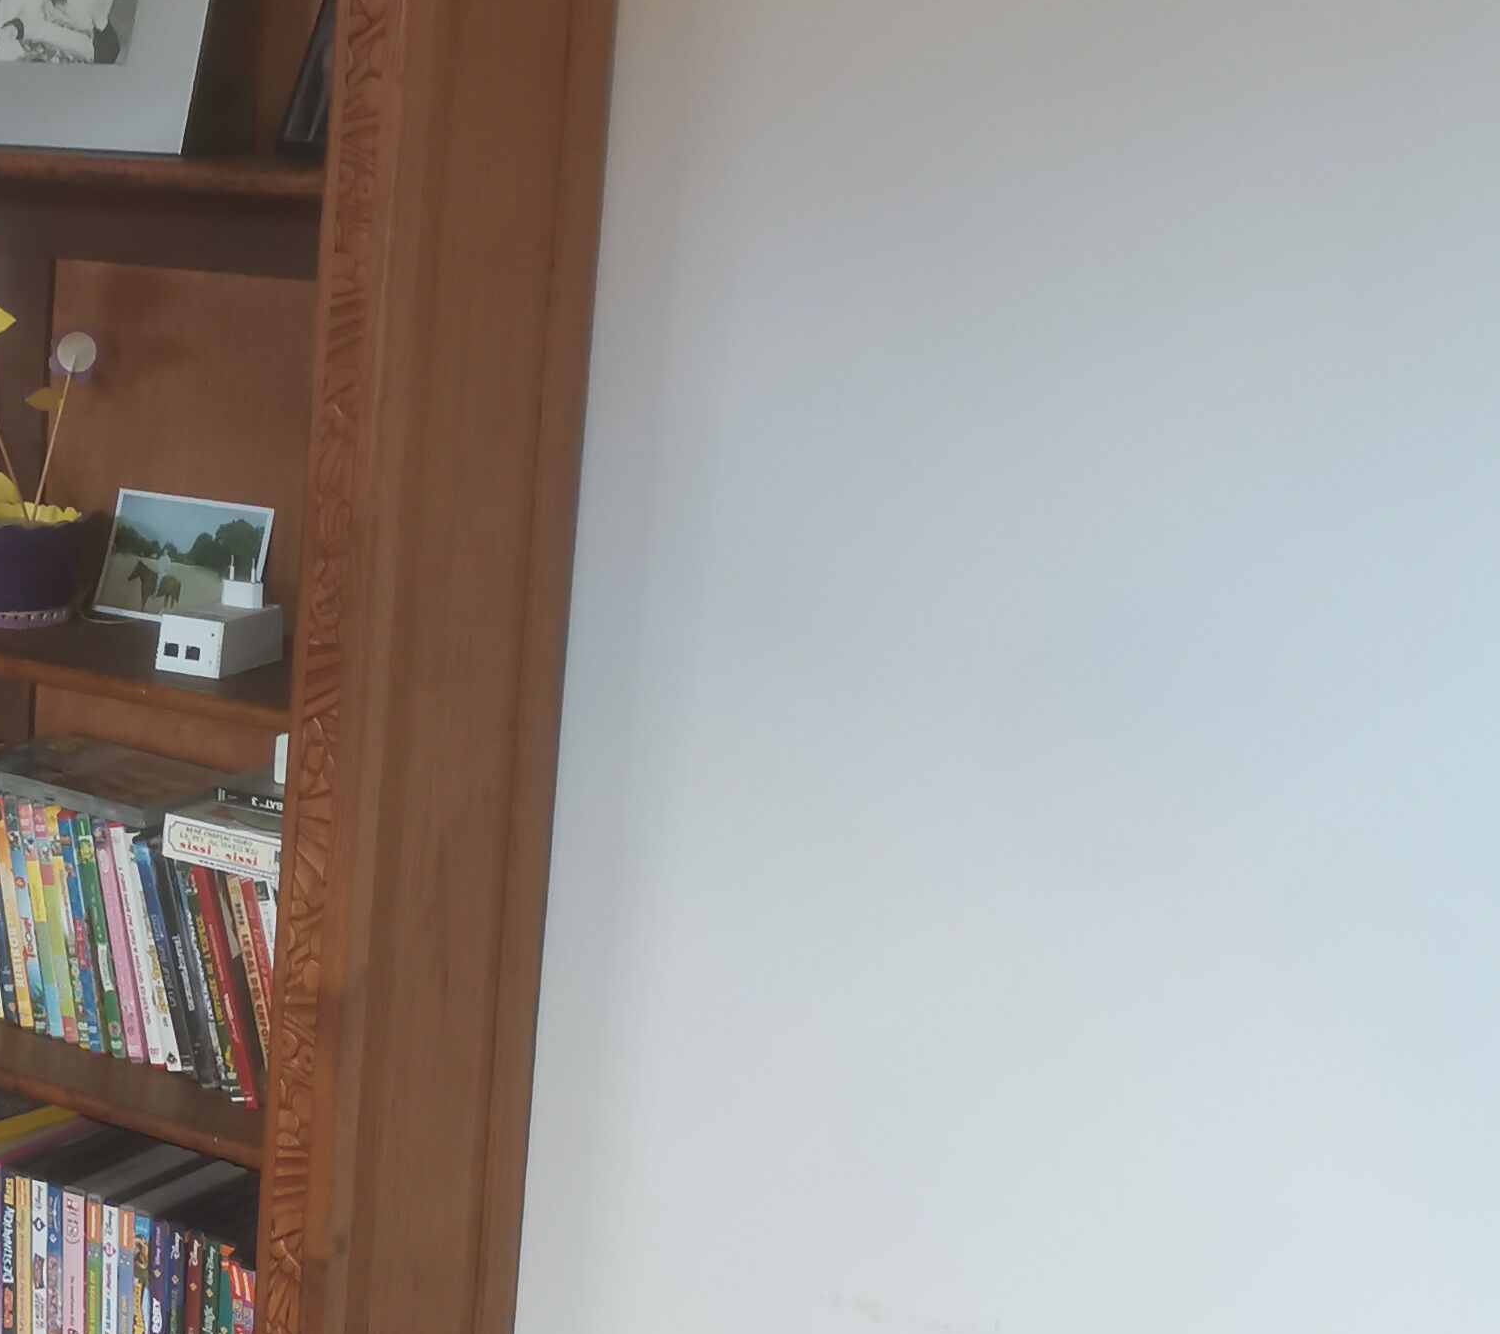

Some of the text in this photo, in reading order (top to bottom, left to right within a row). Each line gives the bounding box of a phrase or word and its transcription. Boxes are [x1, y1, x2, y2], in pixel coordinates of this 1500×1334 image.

[251, 796, 259, 807] 3
[179, 841, 212, 855] sissi
[224, 852, 258, 866] sissi
[8, 923, 23, 989] KIRIKOU
[241, 933, 250, 948] LE
[251, 977, 263, 1002] DES
[4, 1178, 15, 1206] MARS
[34, 1184, 43, 1210] Disney
[104, 1210, 114, 1236] Disney
[1, 1206, 15, 1284] DESTINATION
[170, 1232, 182, 1260] Disney
[188, 1239, 200, 1267] Disney
[206, 1246, 215, 1286] Walt Disney
[151, 1297, 163, 1334] DORY
[202, 1304, 216, 1334] Jungle
